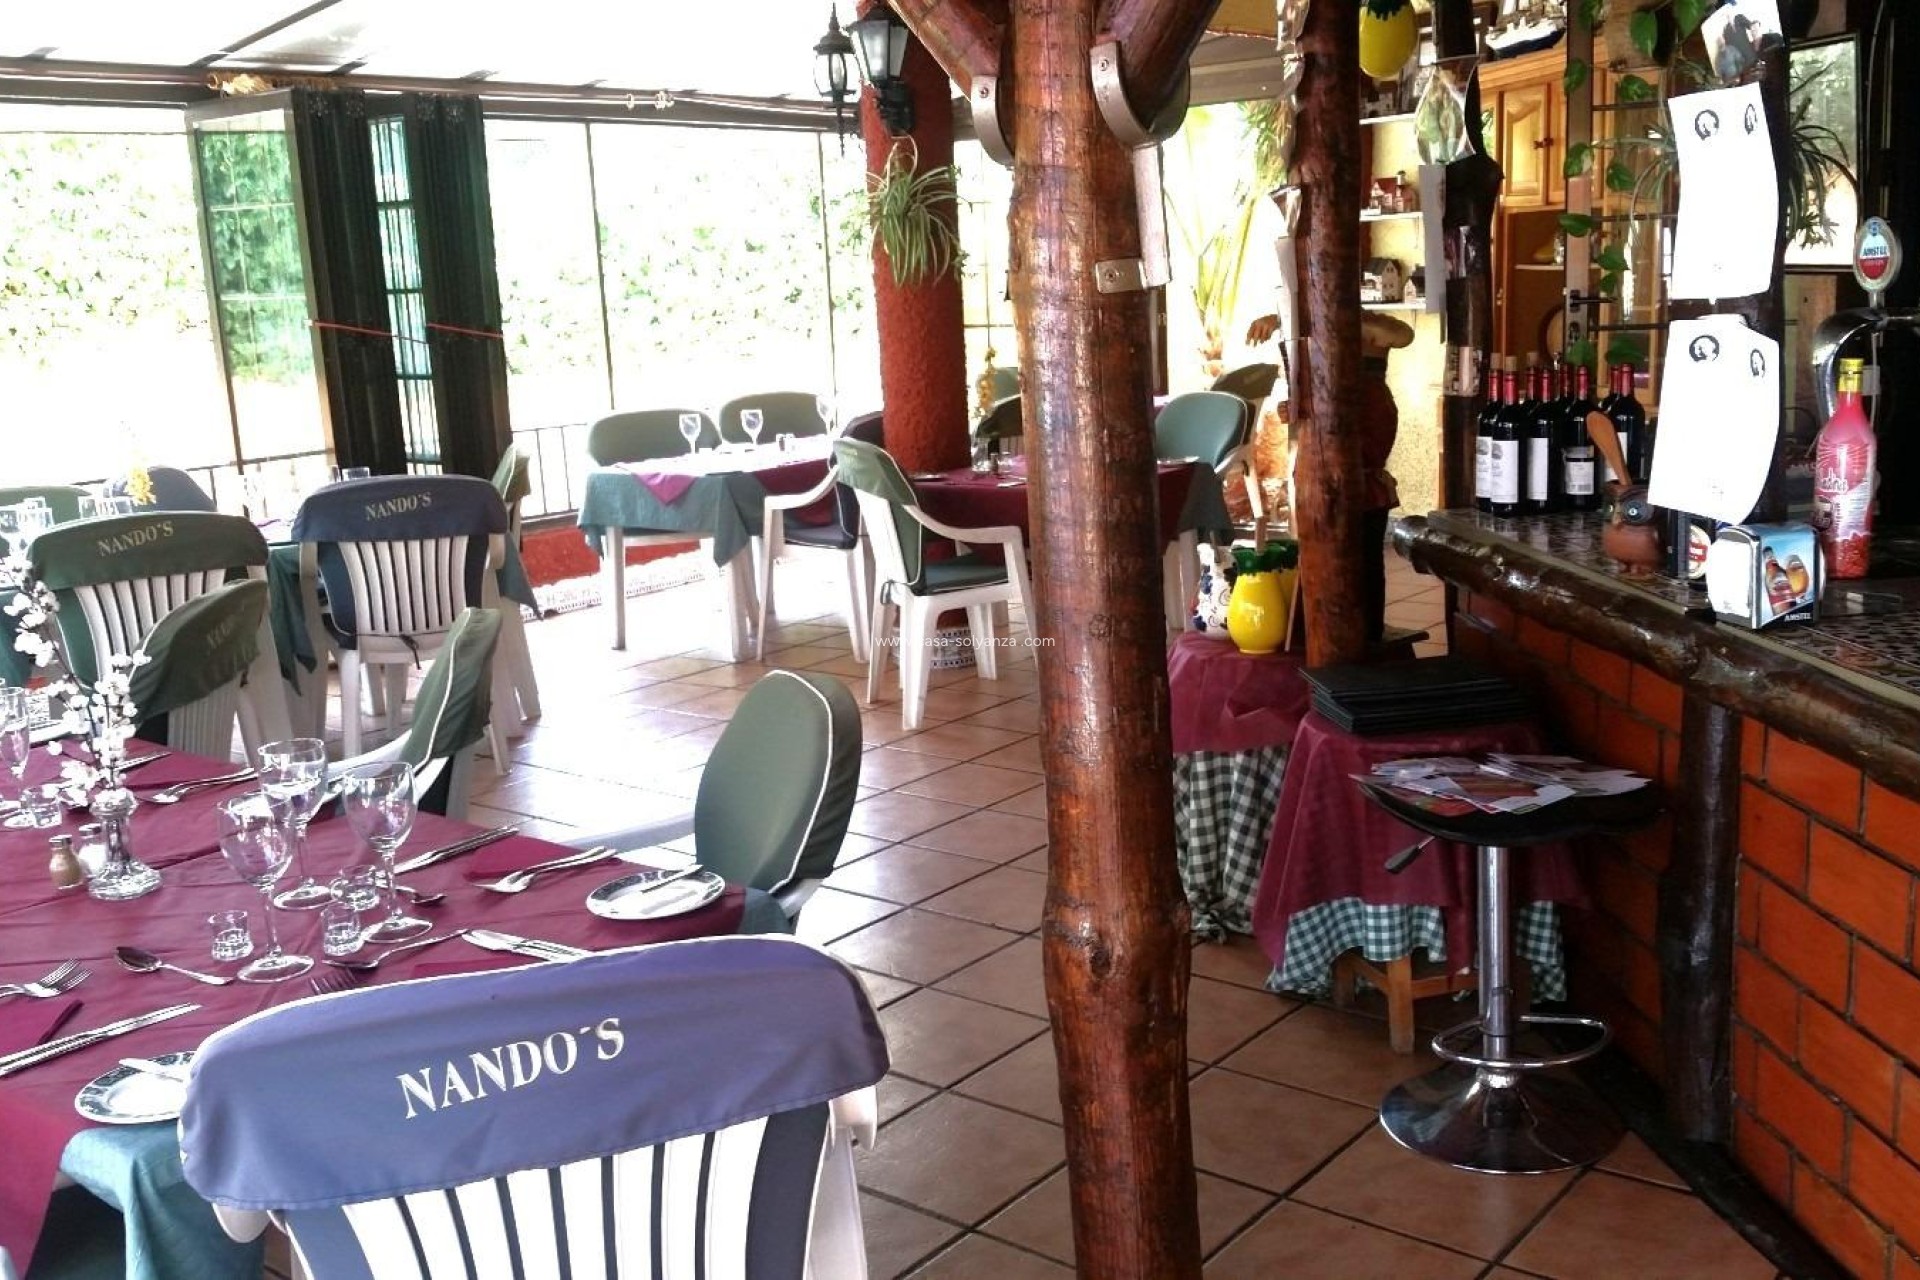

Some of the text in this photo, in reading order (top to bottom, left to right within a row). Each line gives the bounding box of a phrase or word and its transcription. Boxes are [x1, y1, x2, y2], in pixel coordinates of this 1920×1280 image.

[365, 491, 433, 521] NANDO'S
[98, 520, 175, 557] NANDO'S
[394, 1017, 625, 1119] NANDO'S
